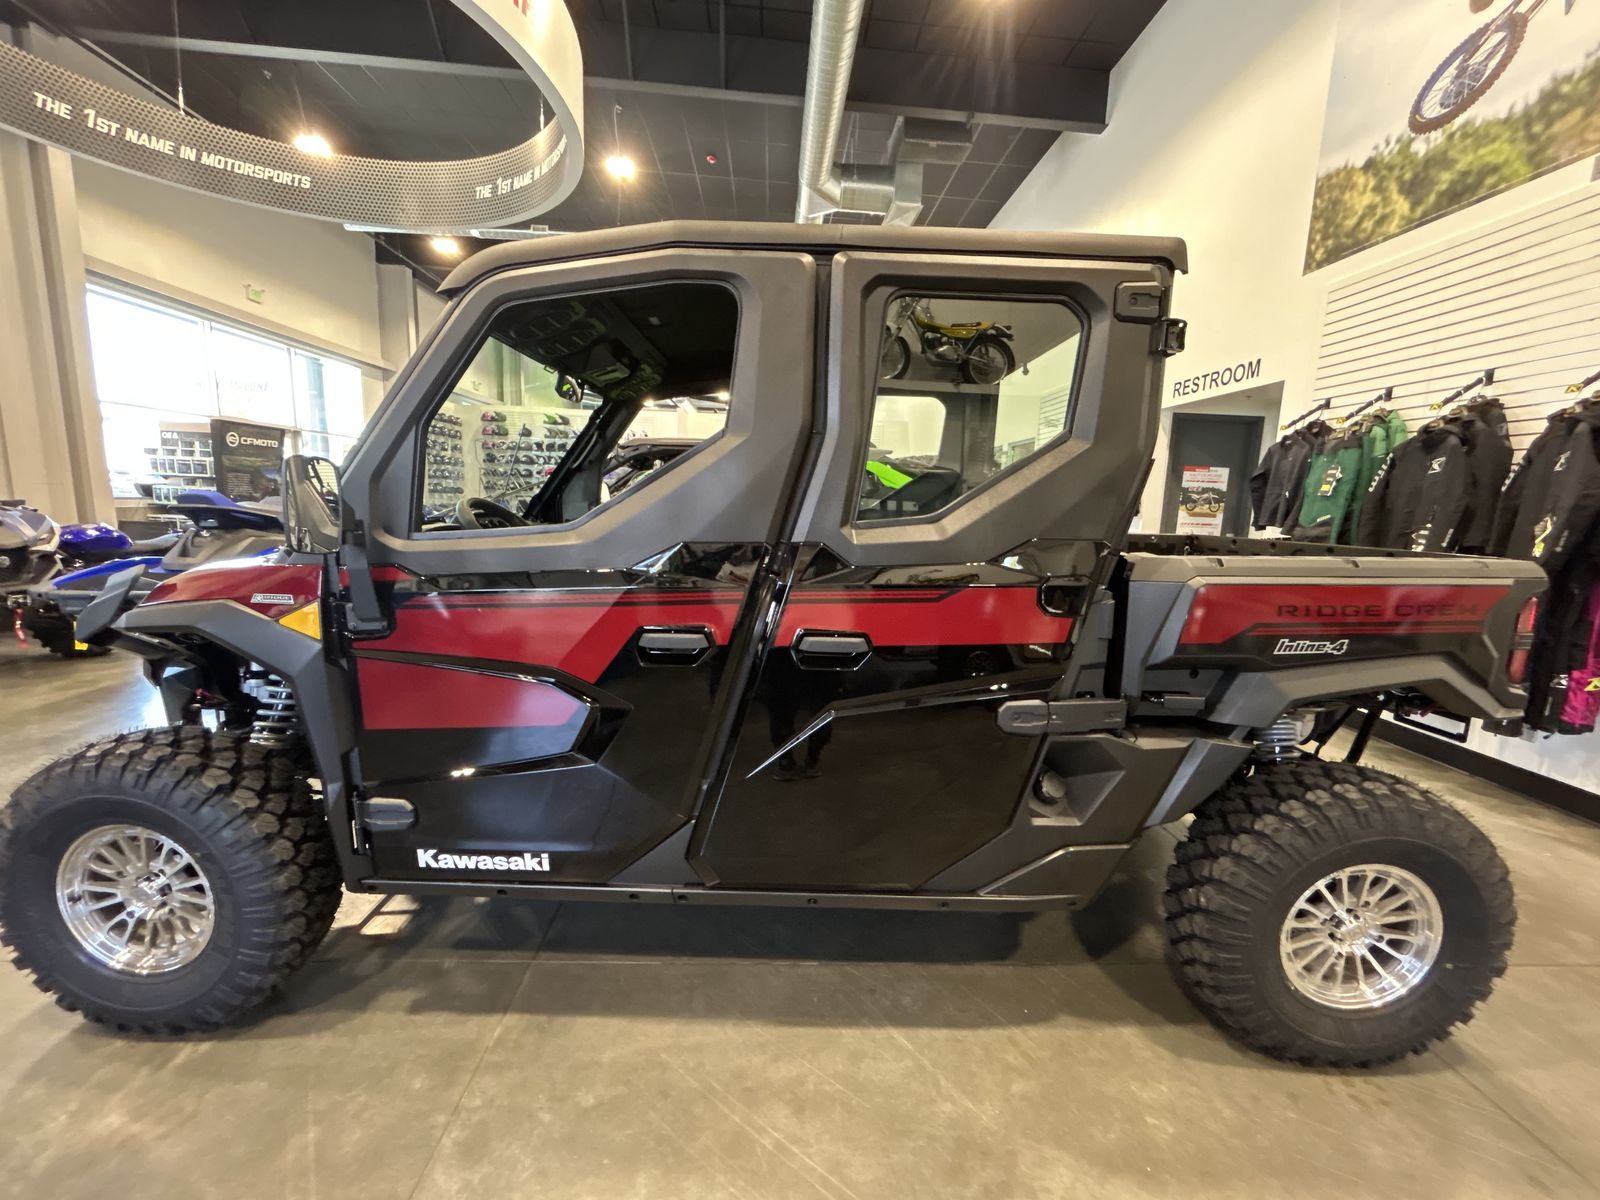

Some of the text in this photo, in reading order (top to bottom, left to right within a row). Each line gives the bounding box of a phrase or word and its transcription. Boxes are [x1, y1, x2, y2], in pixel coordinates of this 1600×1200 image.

[33, 91, 311, 189] THE 1ST NAME IN MOTORSPORTS
[475, 184, 492, 200] THE
[496, 176, 512, 195] 1ST
[513, 169, 533, 191] NAME
[1172, 358, 1262, 399] RESTROOM
[240, 437, 279, 448] CFMOTO
[1277, 604, 1383, 617] RIDGE
[1273, 639, 1349, 655] Inline-4
[416, 849, 550, 871] Kawasaki
